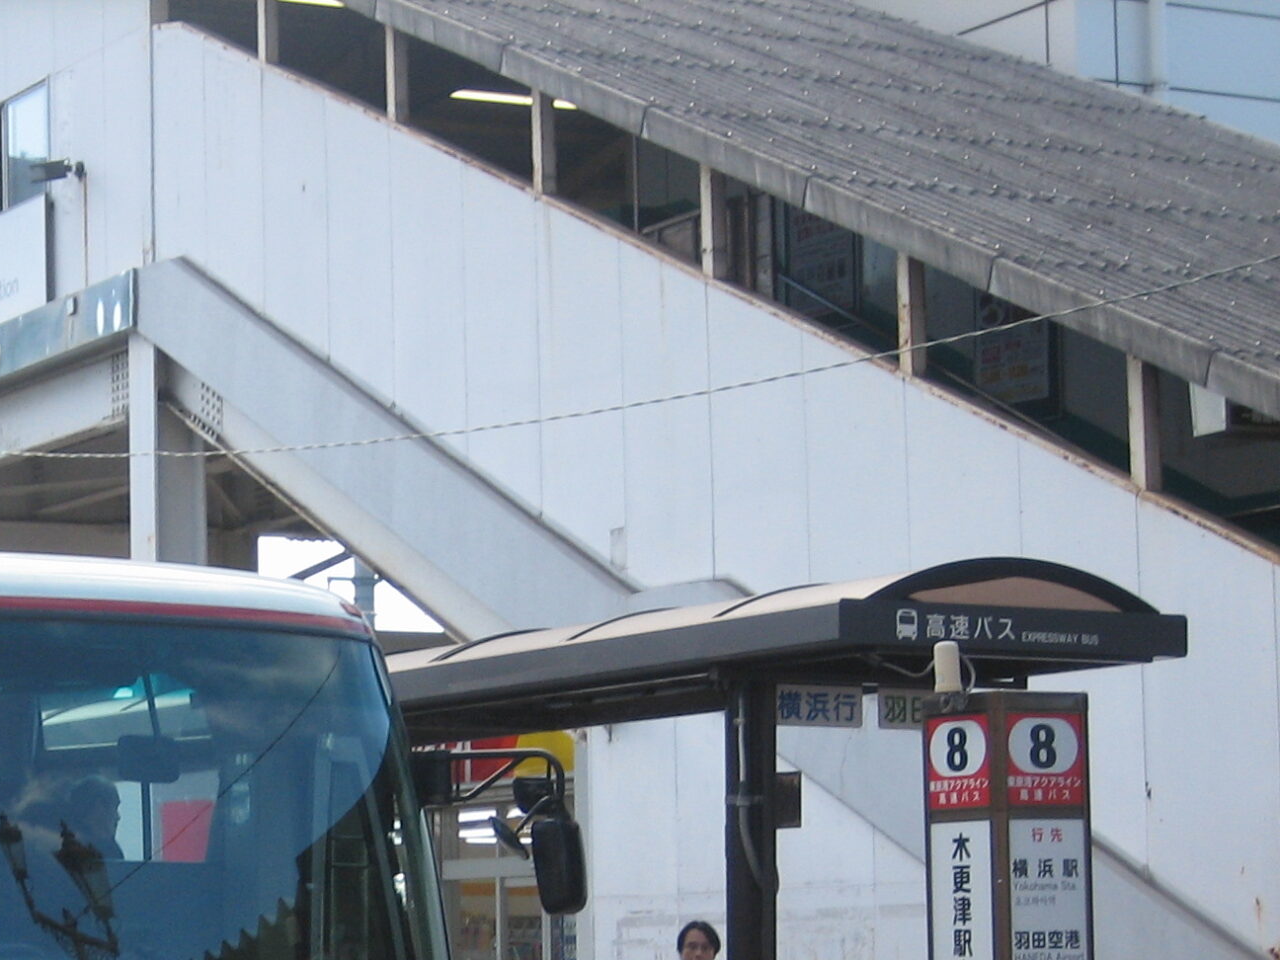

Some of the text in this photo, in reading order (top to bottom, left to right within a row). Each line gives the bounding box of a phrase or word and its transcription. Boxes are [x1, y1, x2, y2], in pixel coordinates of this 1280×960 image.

[926, 613, 1015, 640] 高速バス
[1021, 630, 1099, 646] EXPRESSWAY BUS
[778, 689, 857, 722] 横浜行
[946, 726, 968, 772] 8
[1030, 723, 1057, 769] 8
[1032, 827, 1063, 843] 行先
[1012, 858, 1079, 878] 横浜駅
[1014, 930, 1081, 950] 羽田空港
